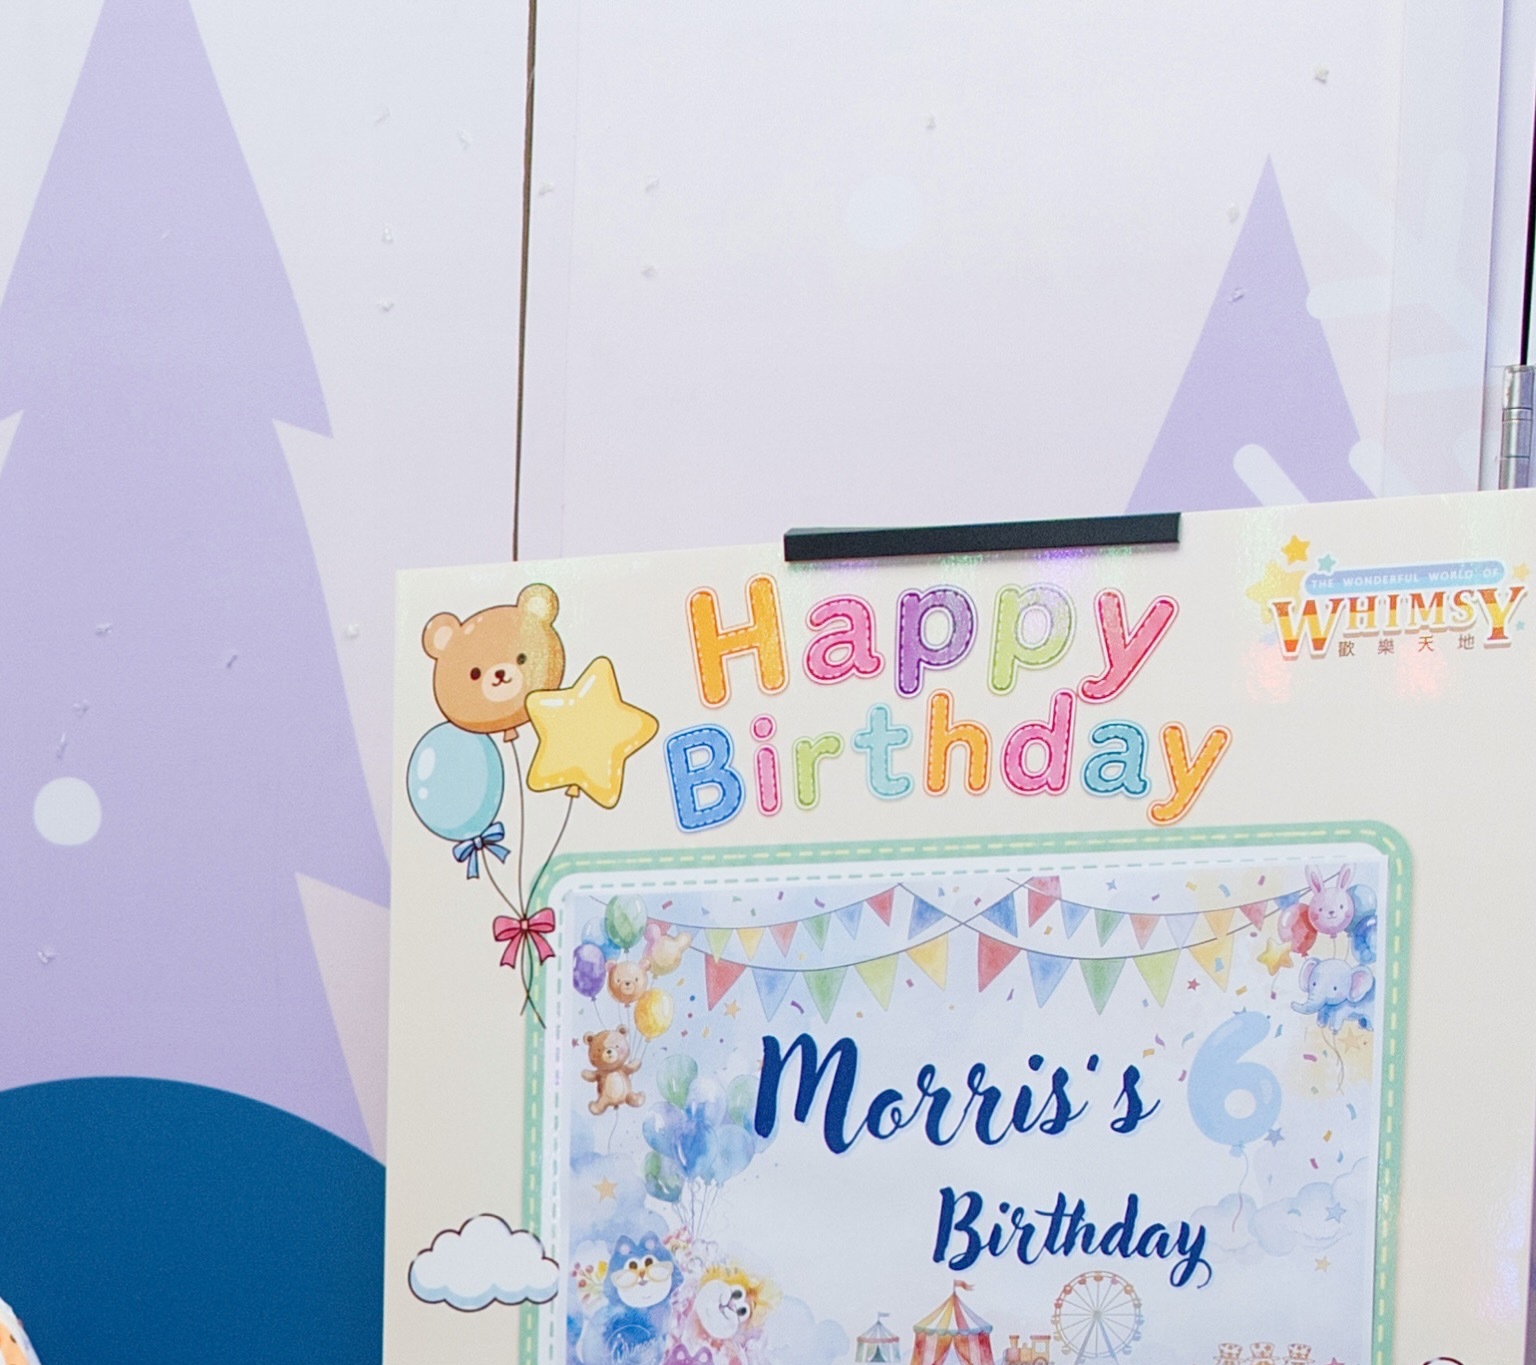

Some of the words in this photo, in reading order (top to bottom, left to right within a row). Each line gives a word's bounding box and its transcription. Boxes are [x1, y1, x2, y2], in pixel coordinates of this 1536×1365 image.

[1272, 586, 1526, 660] WHIMSY
[1311, 579, 1334, 589] THE
[1343, 573, 1419, 587] WONDERFUL
[1429, 569, 1473, 582] WORLD
[1482, 568, 1500, 579] OF
[688, 573, 1178, 705] Happy
[1338, 634, 1475, 657] 歡樂天地
[664, 689, 1232, 833] Birthday
[752, 1033, 1161, 1154] Morris's
[1187, 1010, 1283, 1146] 6
[933, 1188, 1213, 1286] Birthday
